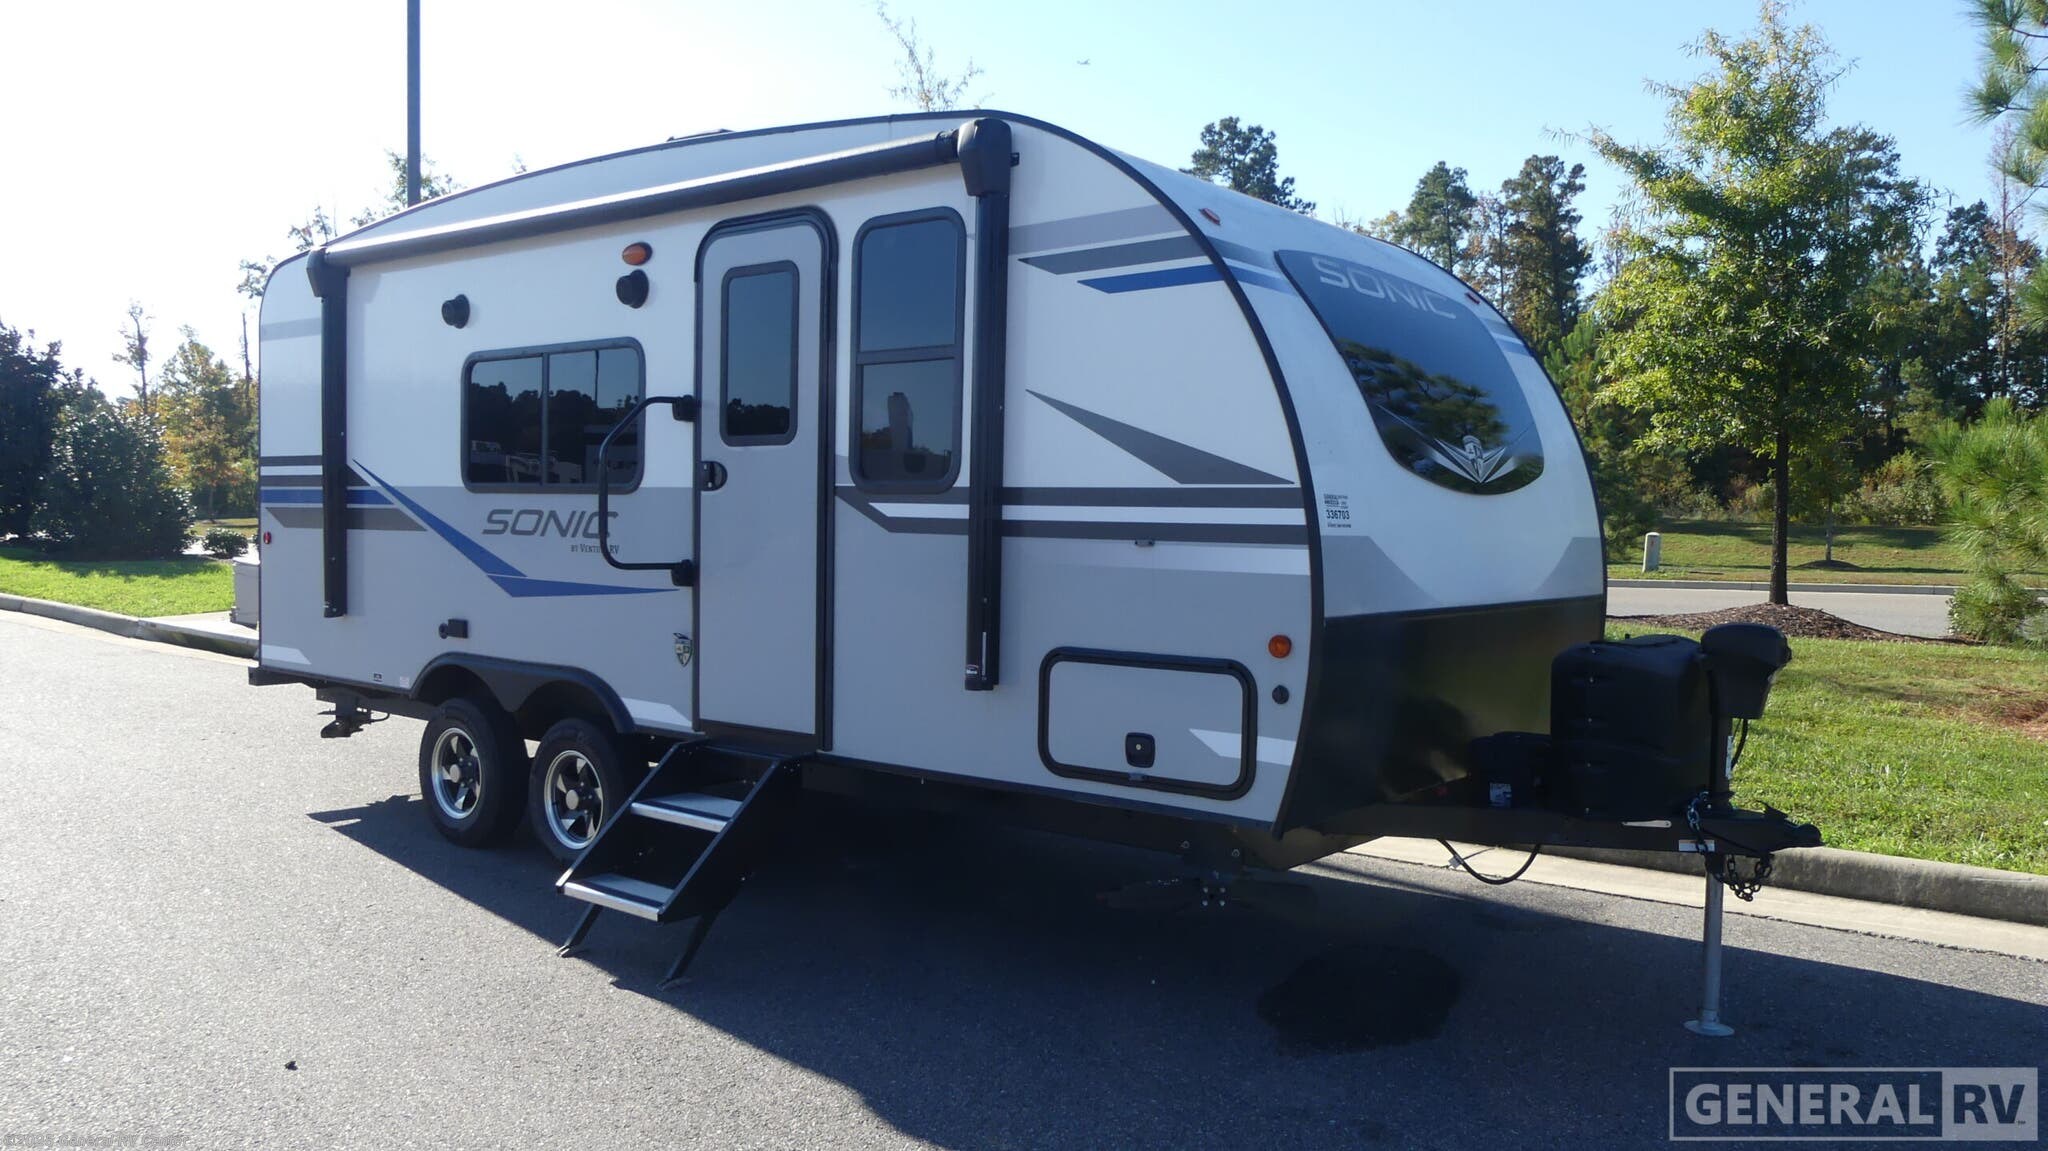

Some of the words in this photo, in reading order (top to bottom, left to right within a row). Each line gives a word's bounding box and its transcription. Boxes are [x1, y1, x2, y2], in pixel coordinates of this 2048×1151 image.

[1311, 256, 1457, 320] SONIC
[481, 508, 619, 539] SONIC
[1326, 509, 1350, 520] 336703
